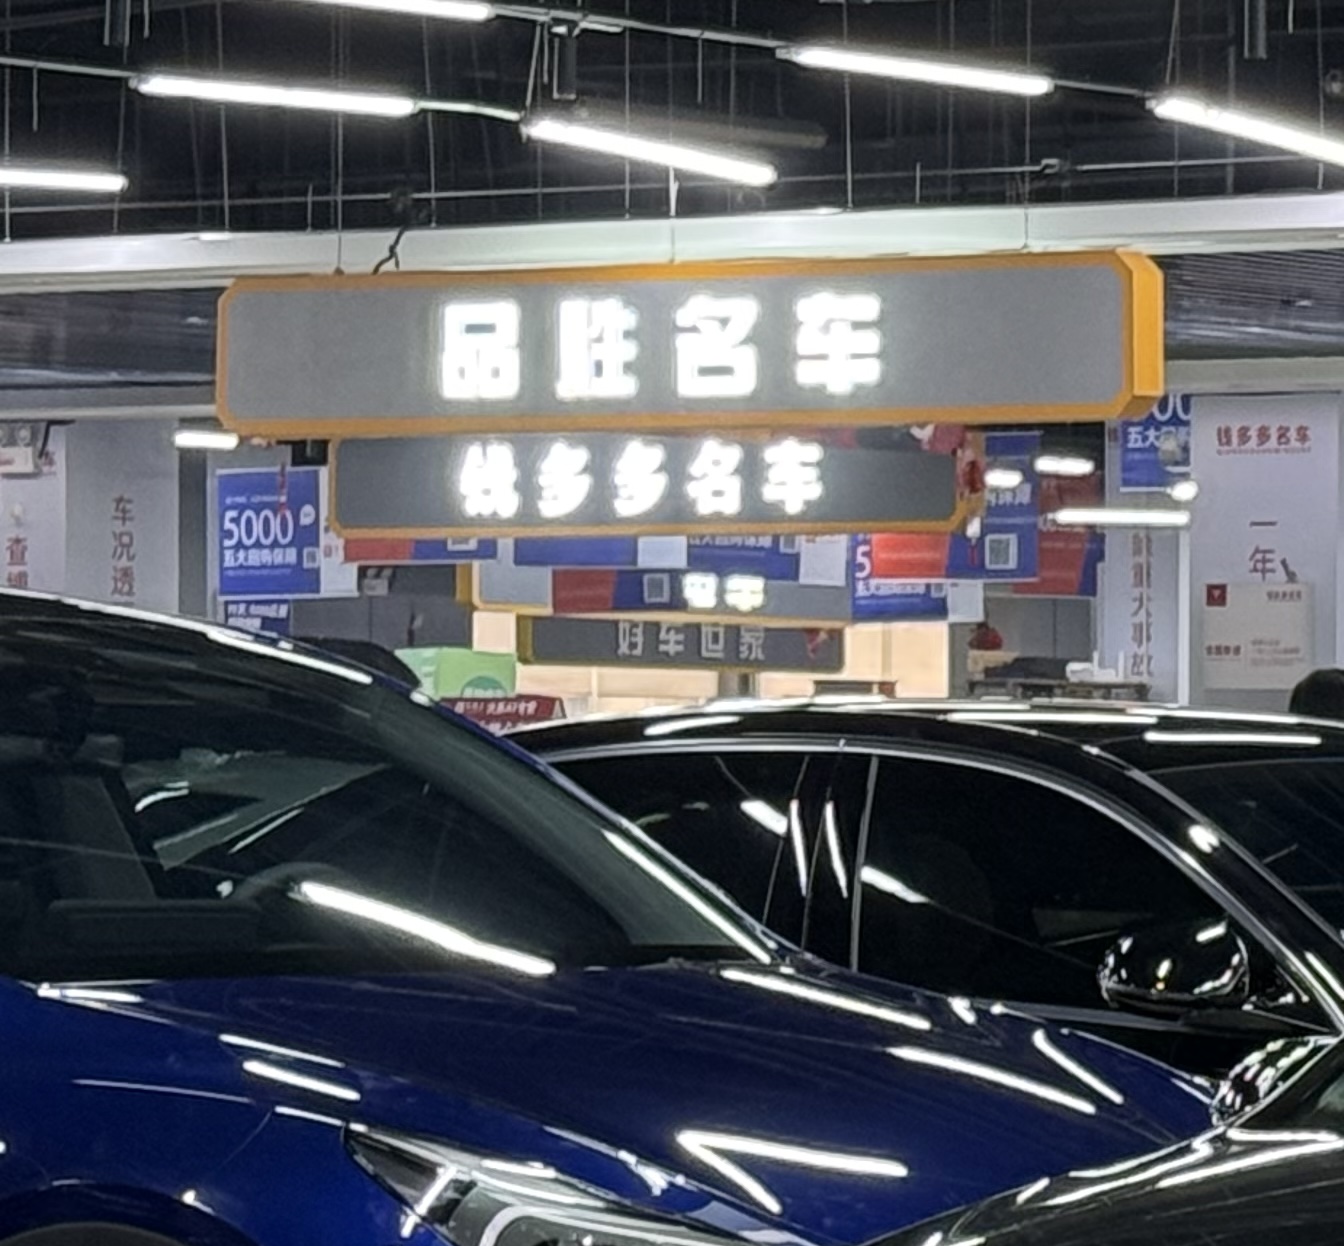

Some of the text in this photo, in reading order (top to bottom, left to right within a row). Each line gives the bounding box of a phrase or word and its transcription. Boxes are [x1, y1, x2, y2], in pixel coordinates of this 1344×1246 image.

[441, 292, 882, 400] 品胜名车
[111, 496, 136, 606] 车况透
[223, 508, 294, 547] 5000
[618, 622, 766, 660] 好车世家
